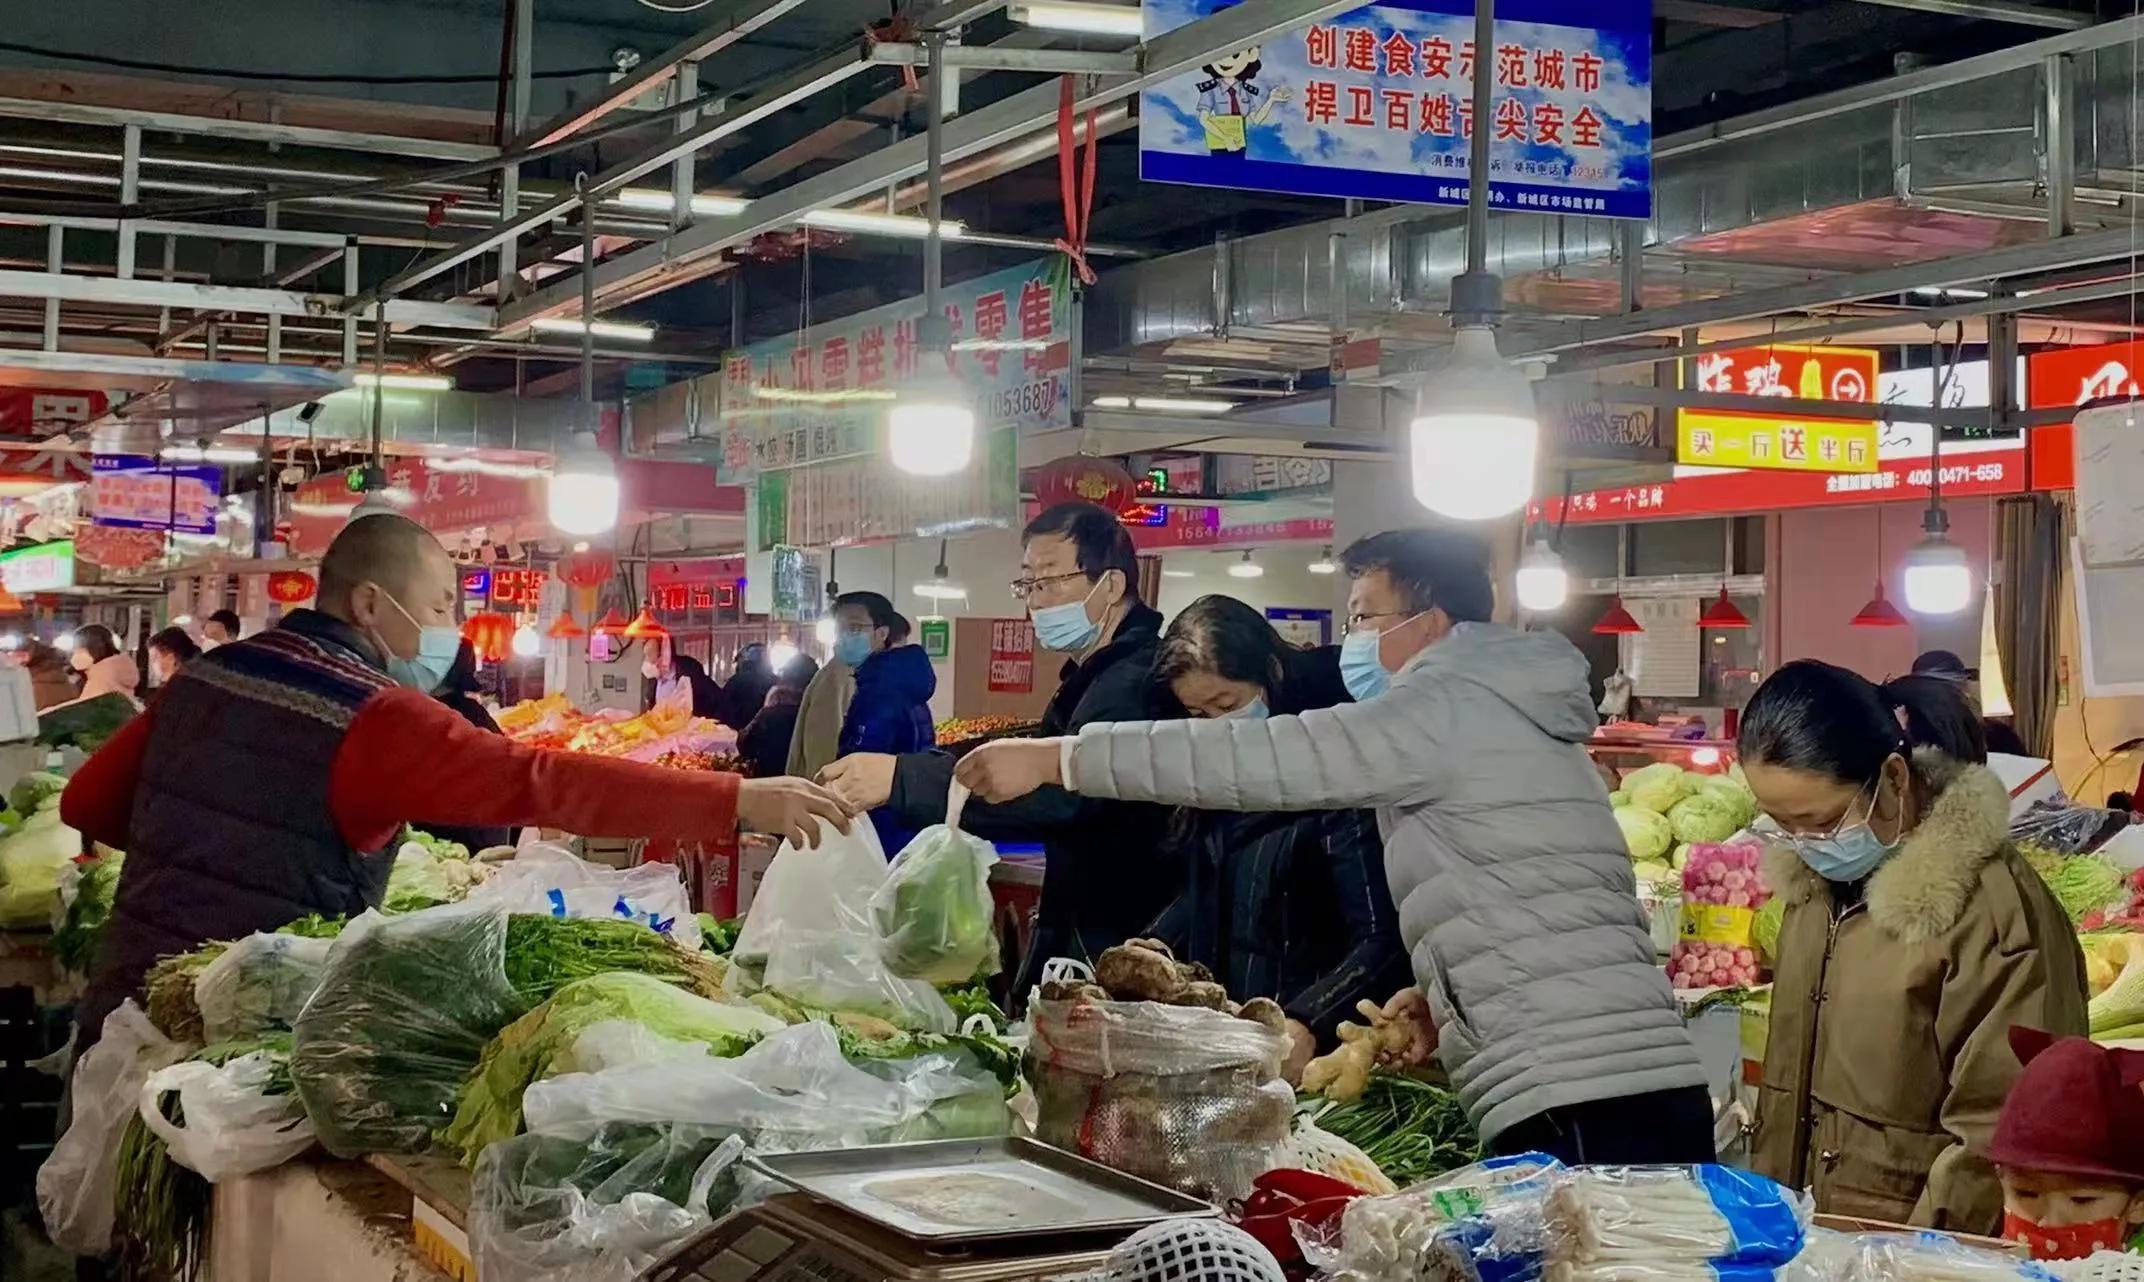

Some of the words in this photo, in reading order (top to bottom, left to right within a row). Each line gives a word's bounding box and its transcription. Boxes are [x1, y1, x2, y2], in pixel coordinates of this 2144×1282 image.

[1431, 154, 1501, 171] 消费维诉
[1697, 352, 1793, 398] 炸鸡
[1693, 427, 1866, 464] 买一斤送半斤
[1906, 463, 2003, 487] 4000471-658
[1609, 485, 1664, 512] 一个品牌
